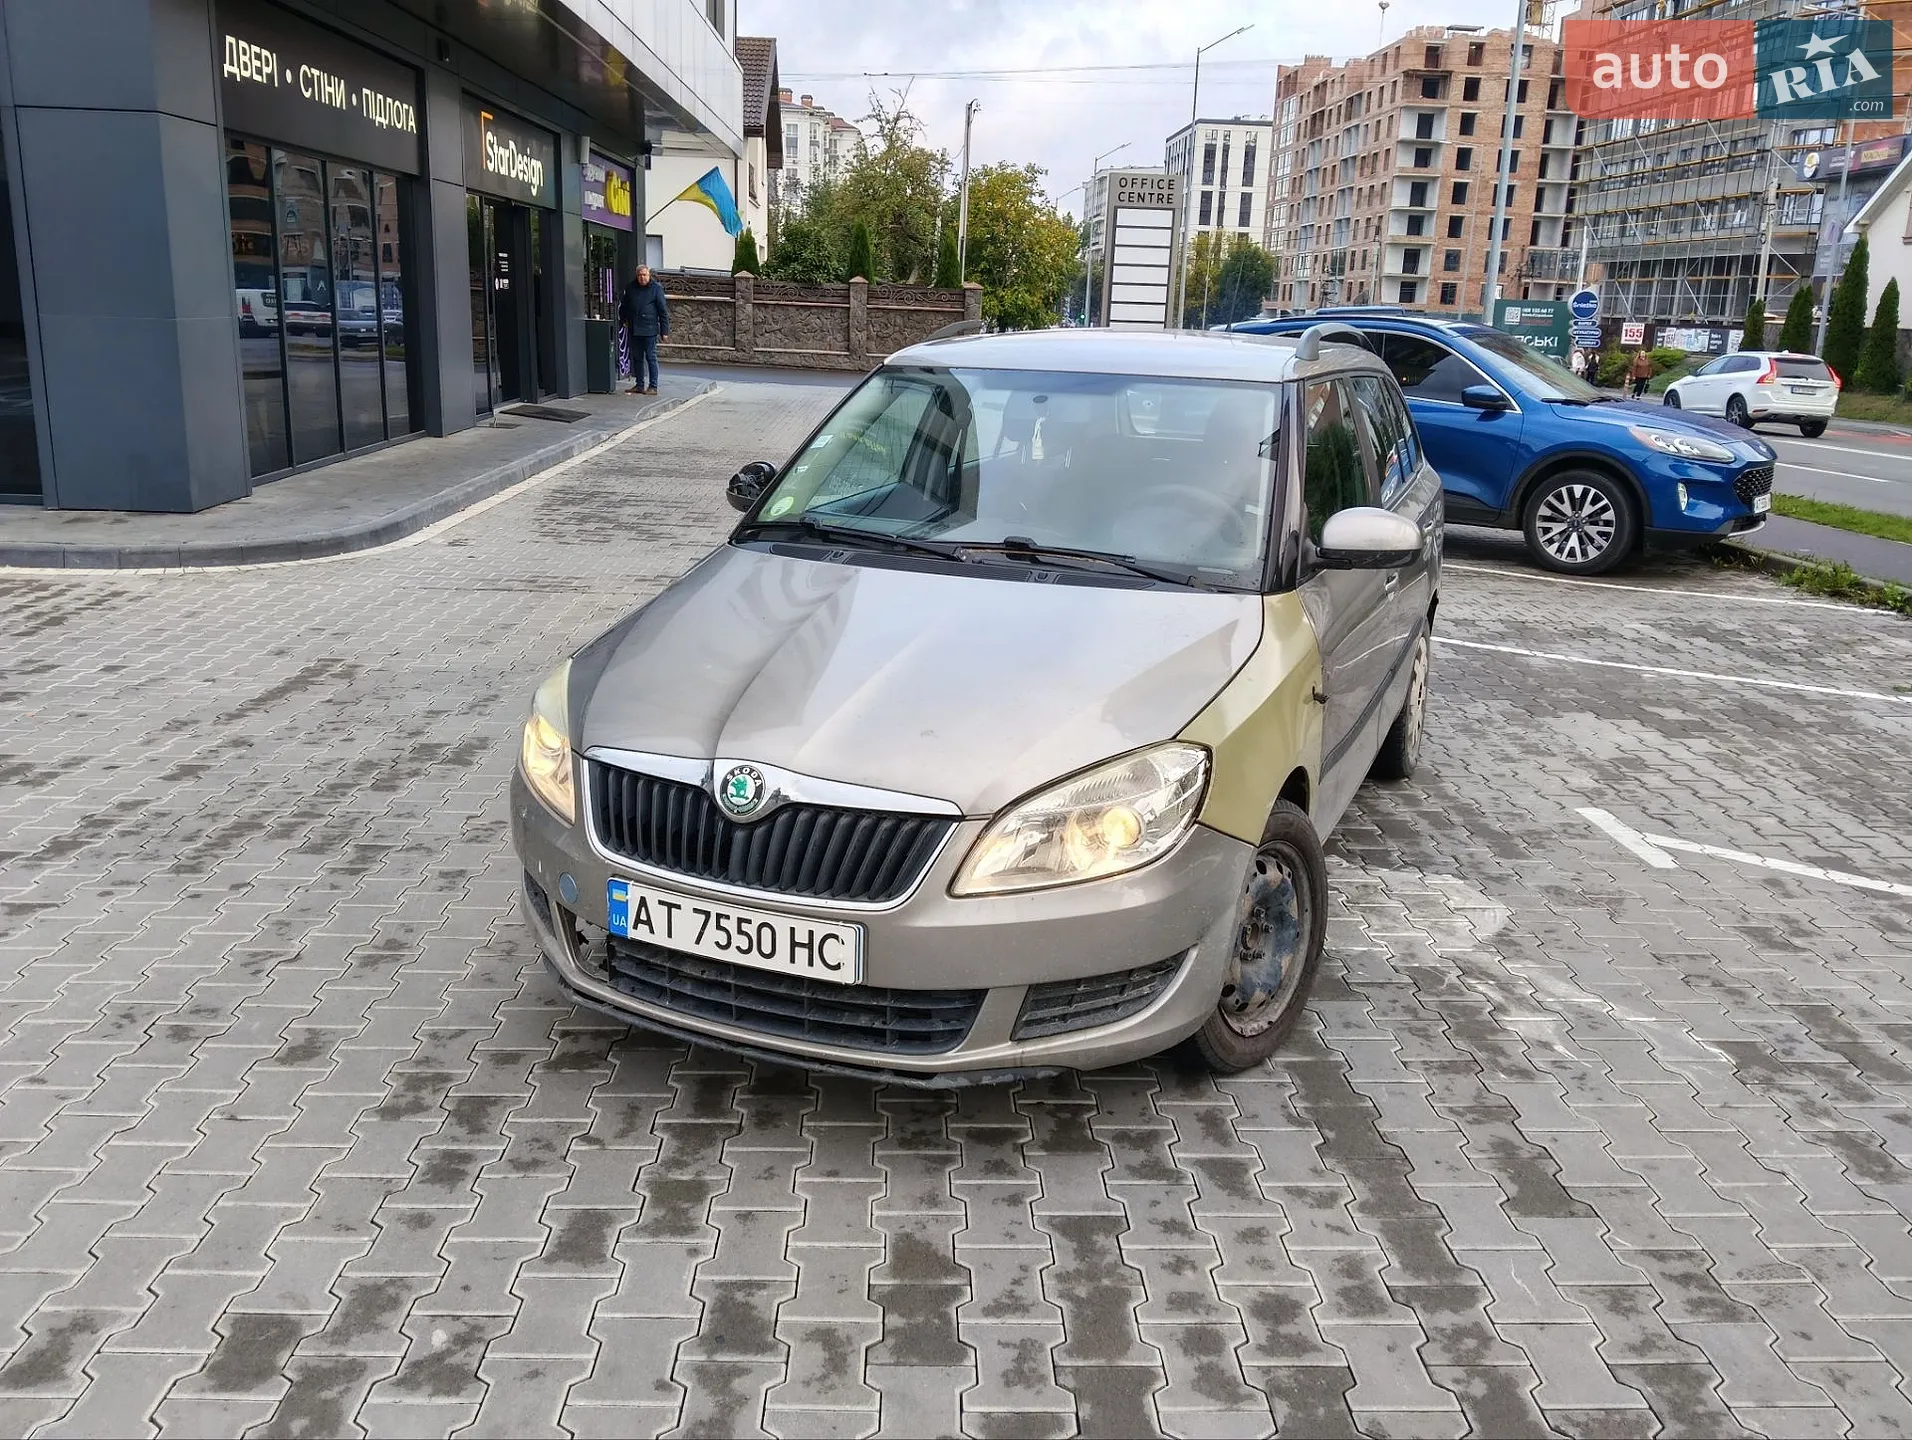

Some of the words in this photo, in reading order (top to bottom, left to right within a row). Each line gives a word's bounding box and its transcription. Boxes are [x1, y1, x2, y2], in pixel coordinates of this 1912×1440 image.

[224, 34, 278, 87] ДВЕРІ
[299, 64, 346, 110] СТІНИ
[362, 88, 417, 134] ПІДЛОГА
[486, 130, 544, 197] StarDesign
[1118, 177, 1176, 190] OFFICE
[1117, 191, 1175, 204] CENTRE
[1624, 328, 1645, 338] 155
[612, 913, 627, 927] UA
[632, 895, 682, 939] AT
[692, 907, 778, 960] 7550
[789, 926, 846, 971] HC
